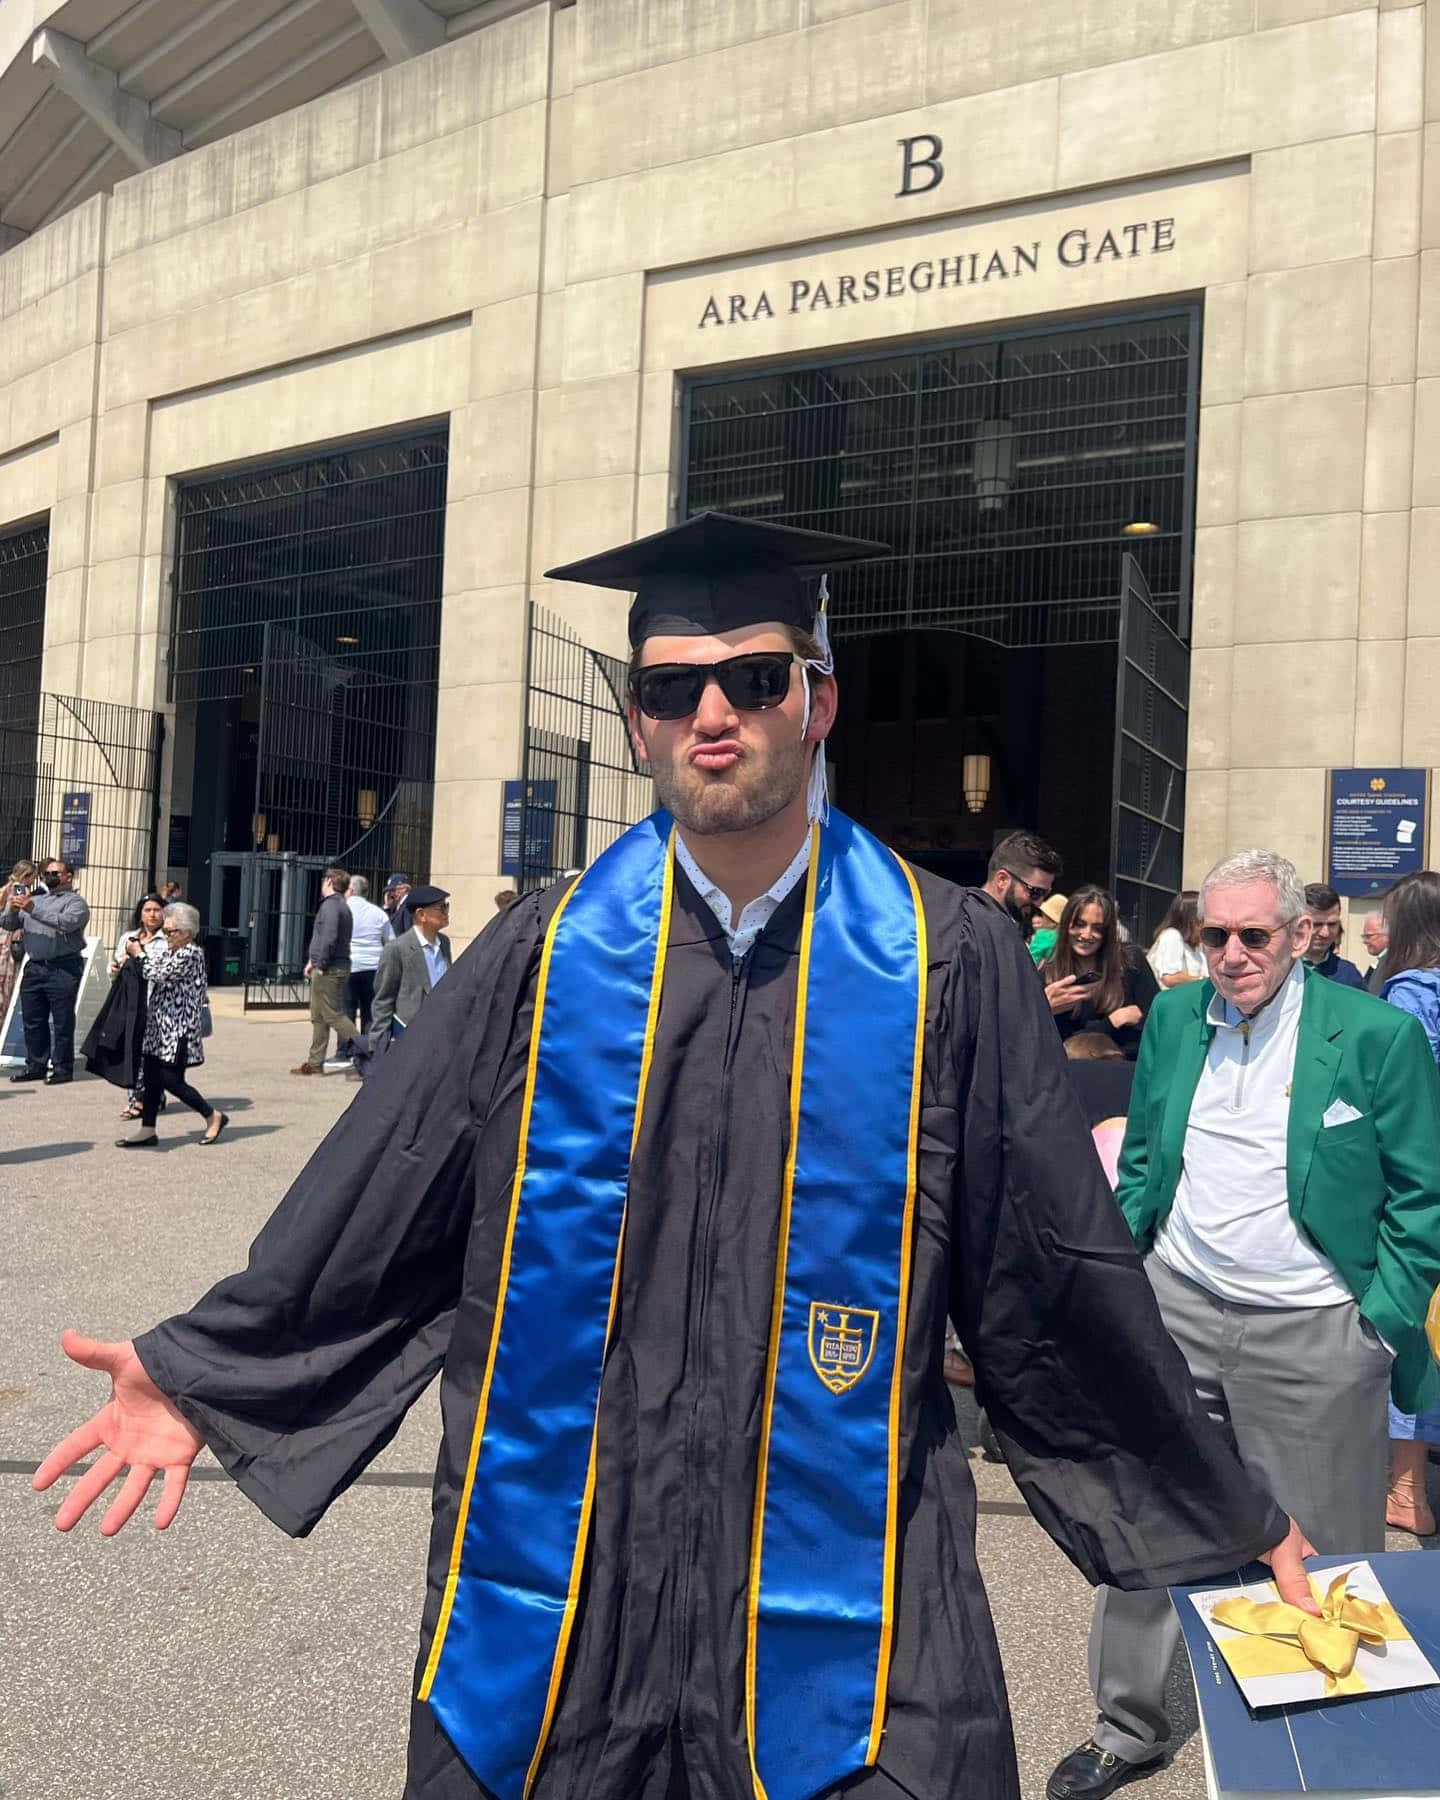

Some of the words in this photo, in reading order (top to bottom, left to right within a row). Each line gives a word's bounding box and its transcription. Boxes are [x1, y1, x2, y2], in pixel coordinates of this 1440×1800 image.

[894, 133, 944, 199] B
[697, 289, 775, 329] ARA
[788, 240, 1041, 314] PARSEGHIAN
[1056, 217, 1176, 268] GATE
[1375, 798, 1419, 806] GUIDELINES
